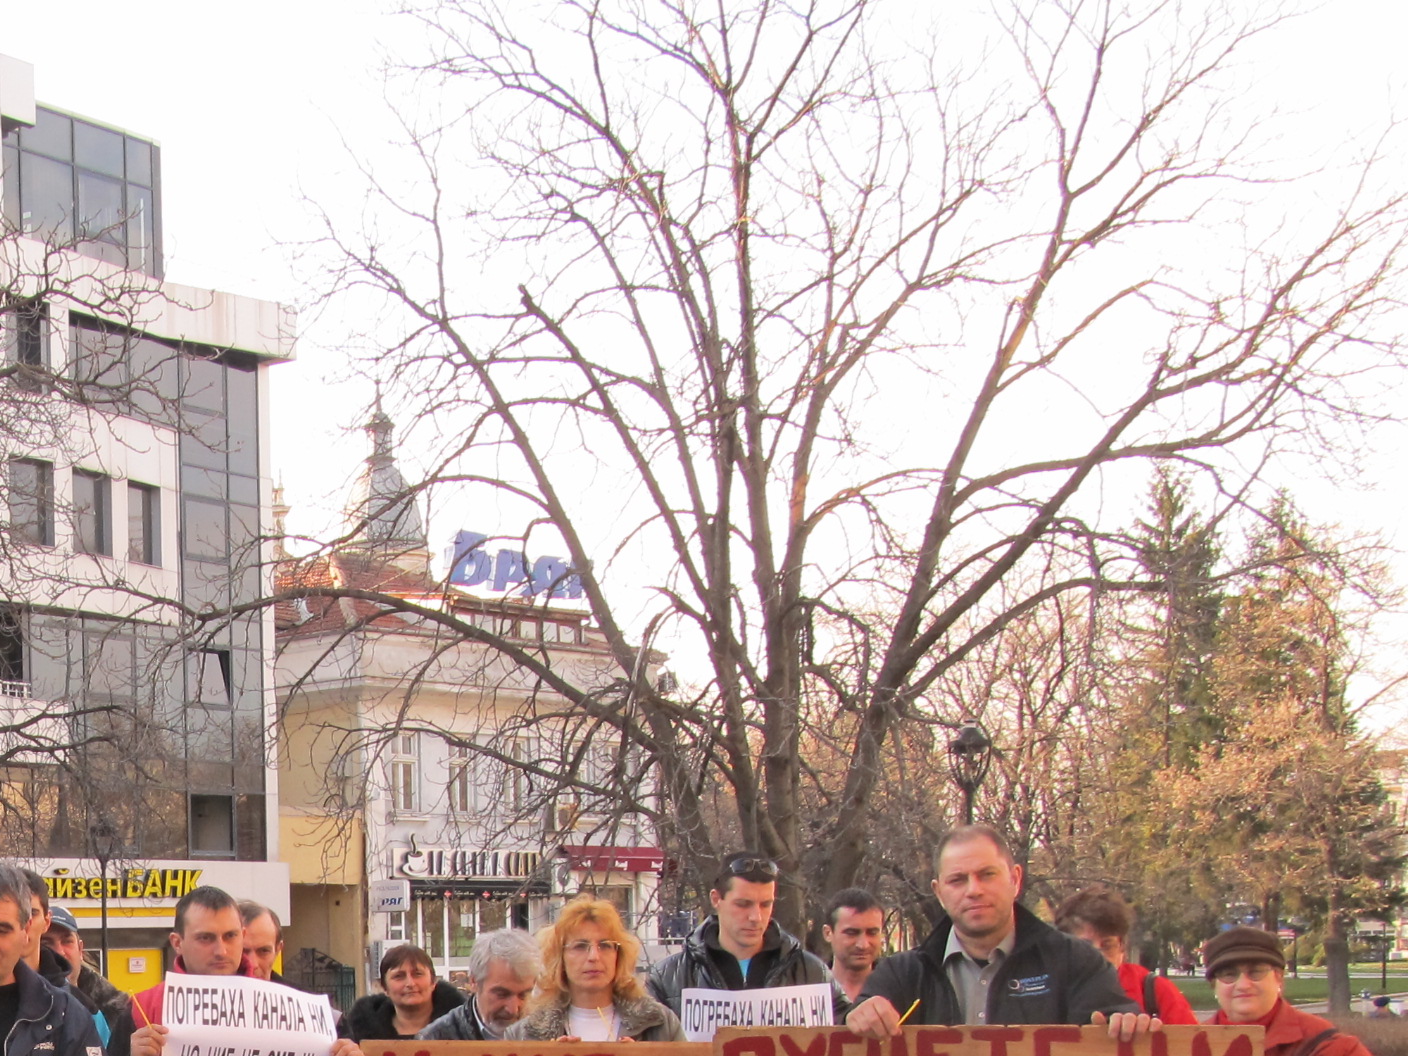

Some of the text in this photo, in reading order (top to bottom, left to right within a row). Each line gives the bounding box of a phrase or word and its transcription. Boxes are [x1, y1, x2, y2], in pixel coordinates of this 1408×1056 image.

[166, 985, 246, 1029] ПОГРЕБАХА
[253, 990, 307, 1032] КАНАЛА
[684, 998, 753, 1033] ПОГРЕБАХА
[760, 997, 806, 1027] КАНАЛА
